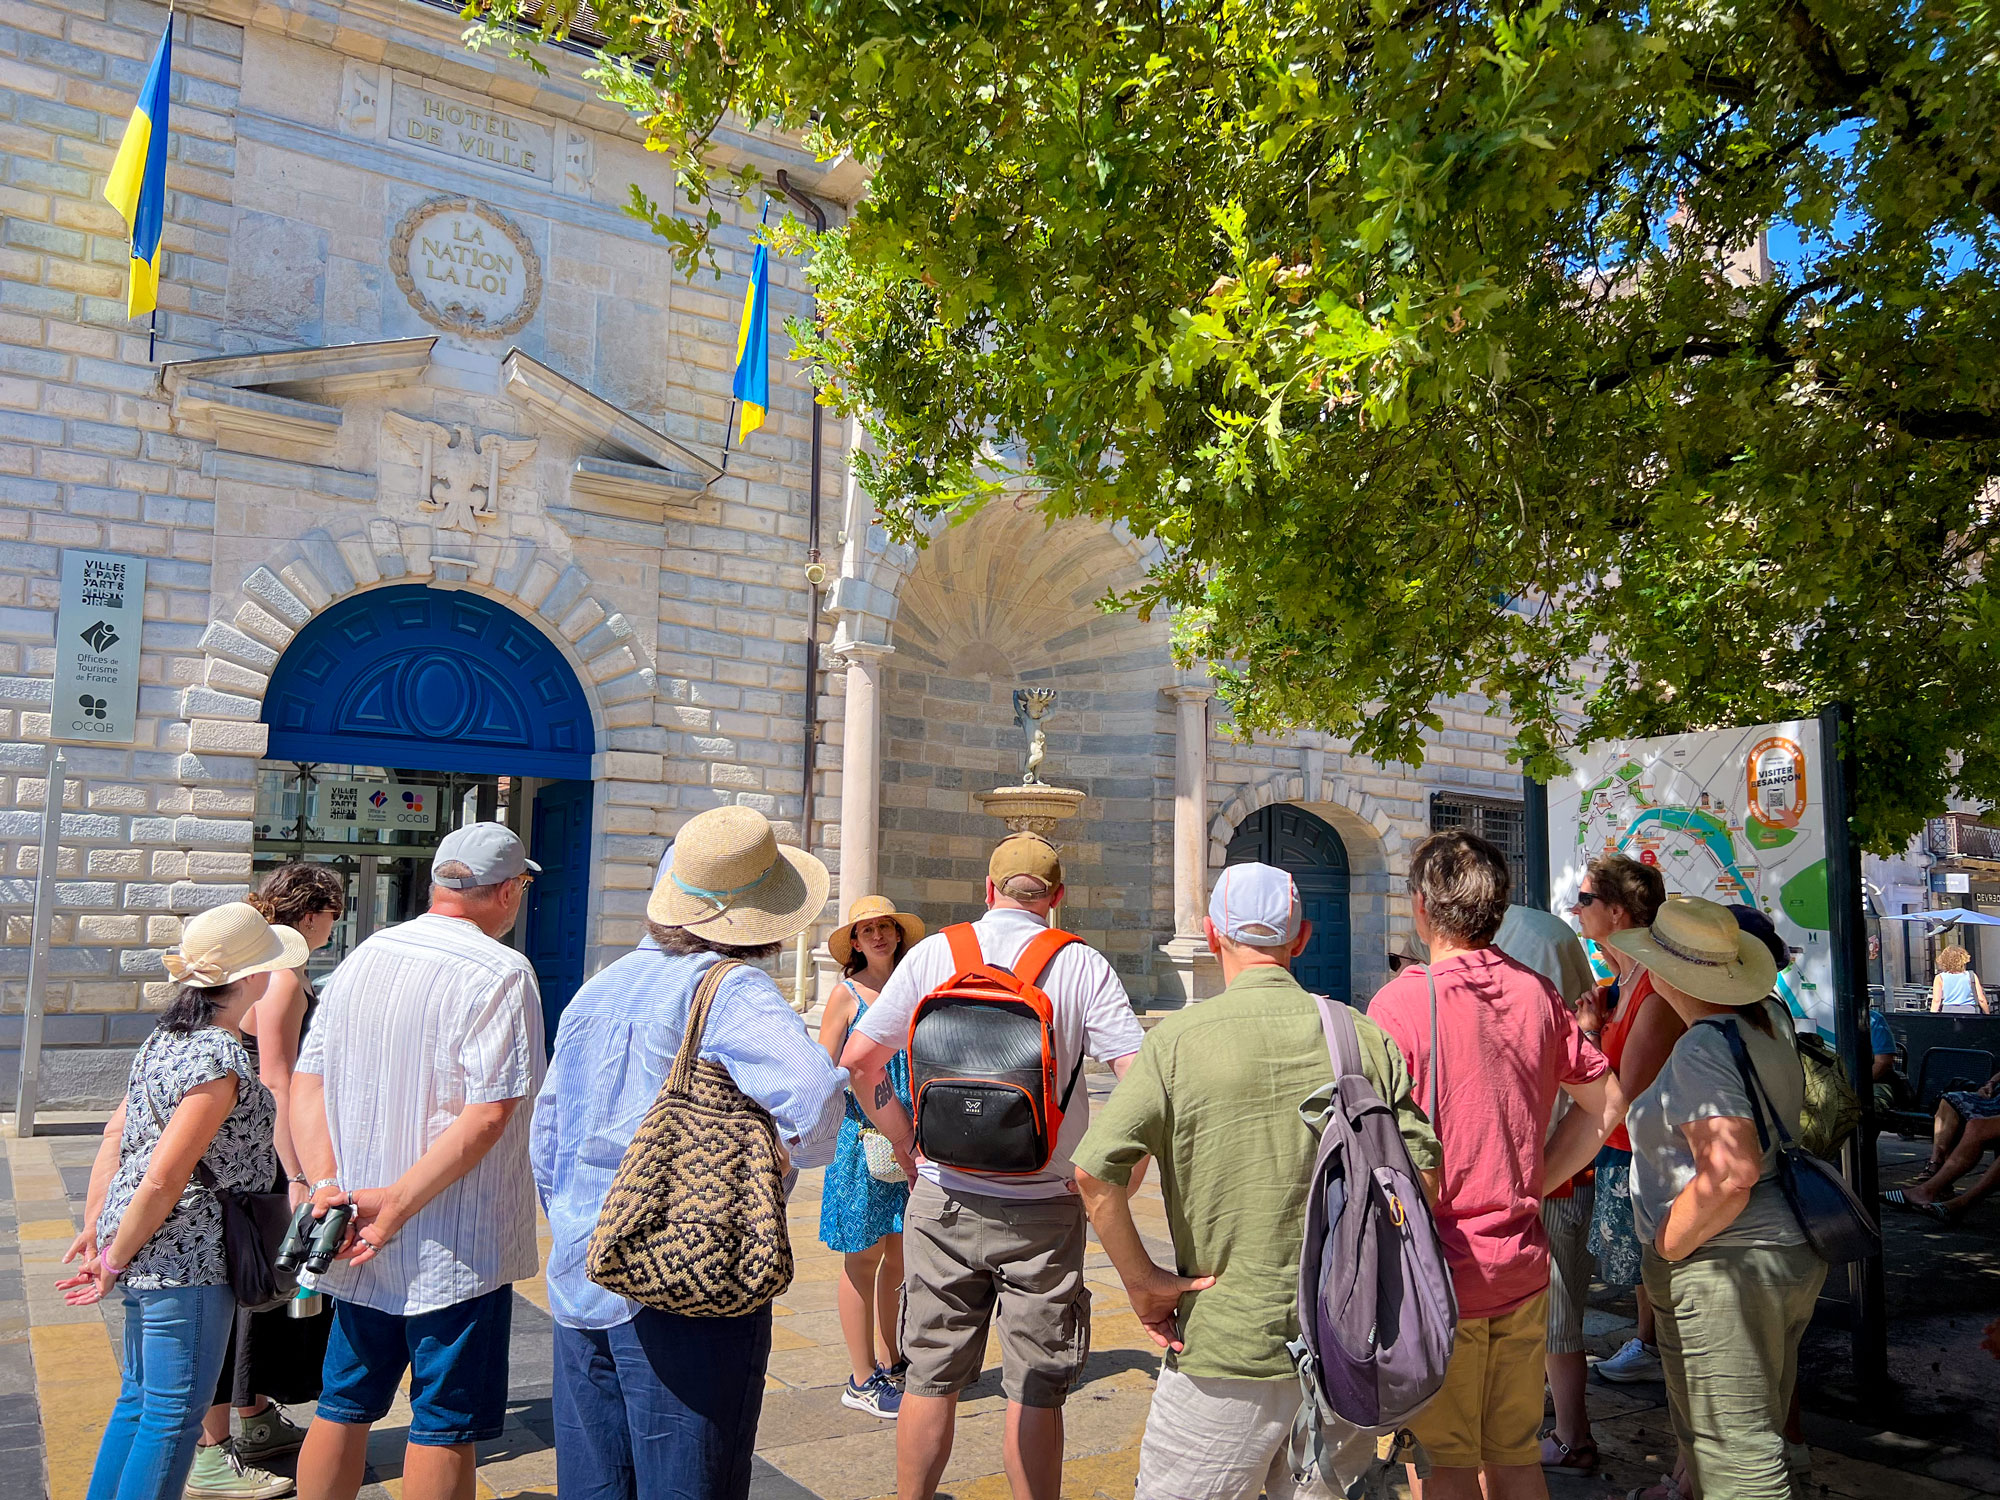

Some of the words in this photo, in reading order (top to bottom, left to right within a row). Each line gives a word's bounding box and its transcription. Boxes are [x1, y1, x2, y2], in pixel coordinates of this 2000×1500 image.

[424, 98, 518, 142] HOTEL
[407, 119, 442, 146] DE
[457, 133, 536, 172] VILLE
[453, 221, 485, 247] LA
[421, 236, 513, 275] NATION
[427, 259, 459, 287] LA
[465, 269, 507, 295] LOI
[85, 560, 126, 573] VILLES
[96, 570, 125, 582] PAYS
[77, 653, 108, 664] Offices
[77, 662, 118, 674] Tourisme
[86, 673, 118, 683] France
[1758, 766, 1793, 778] VISITER
[1751, 773, 1801, 788] BESANÇON
